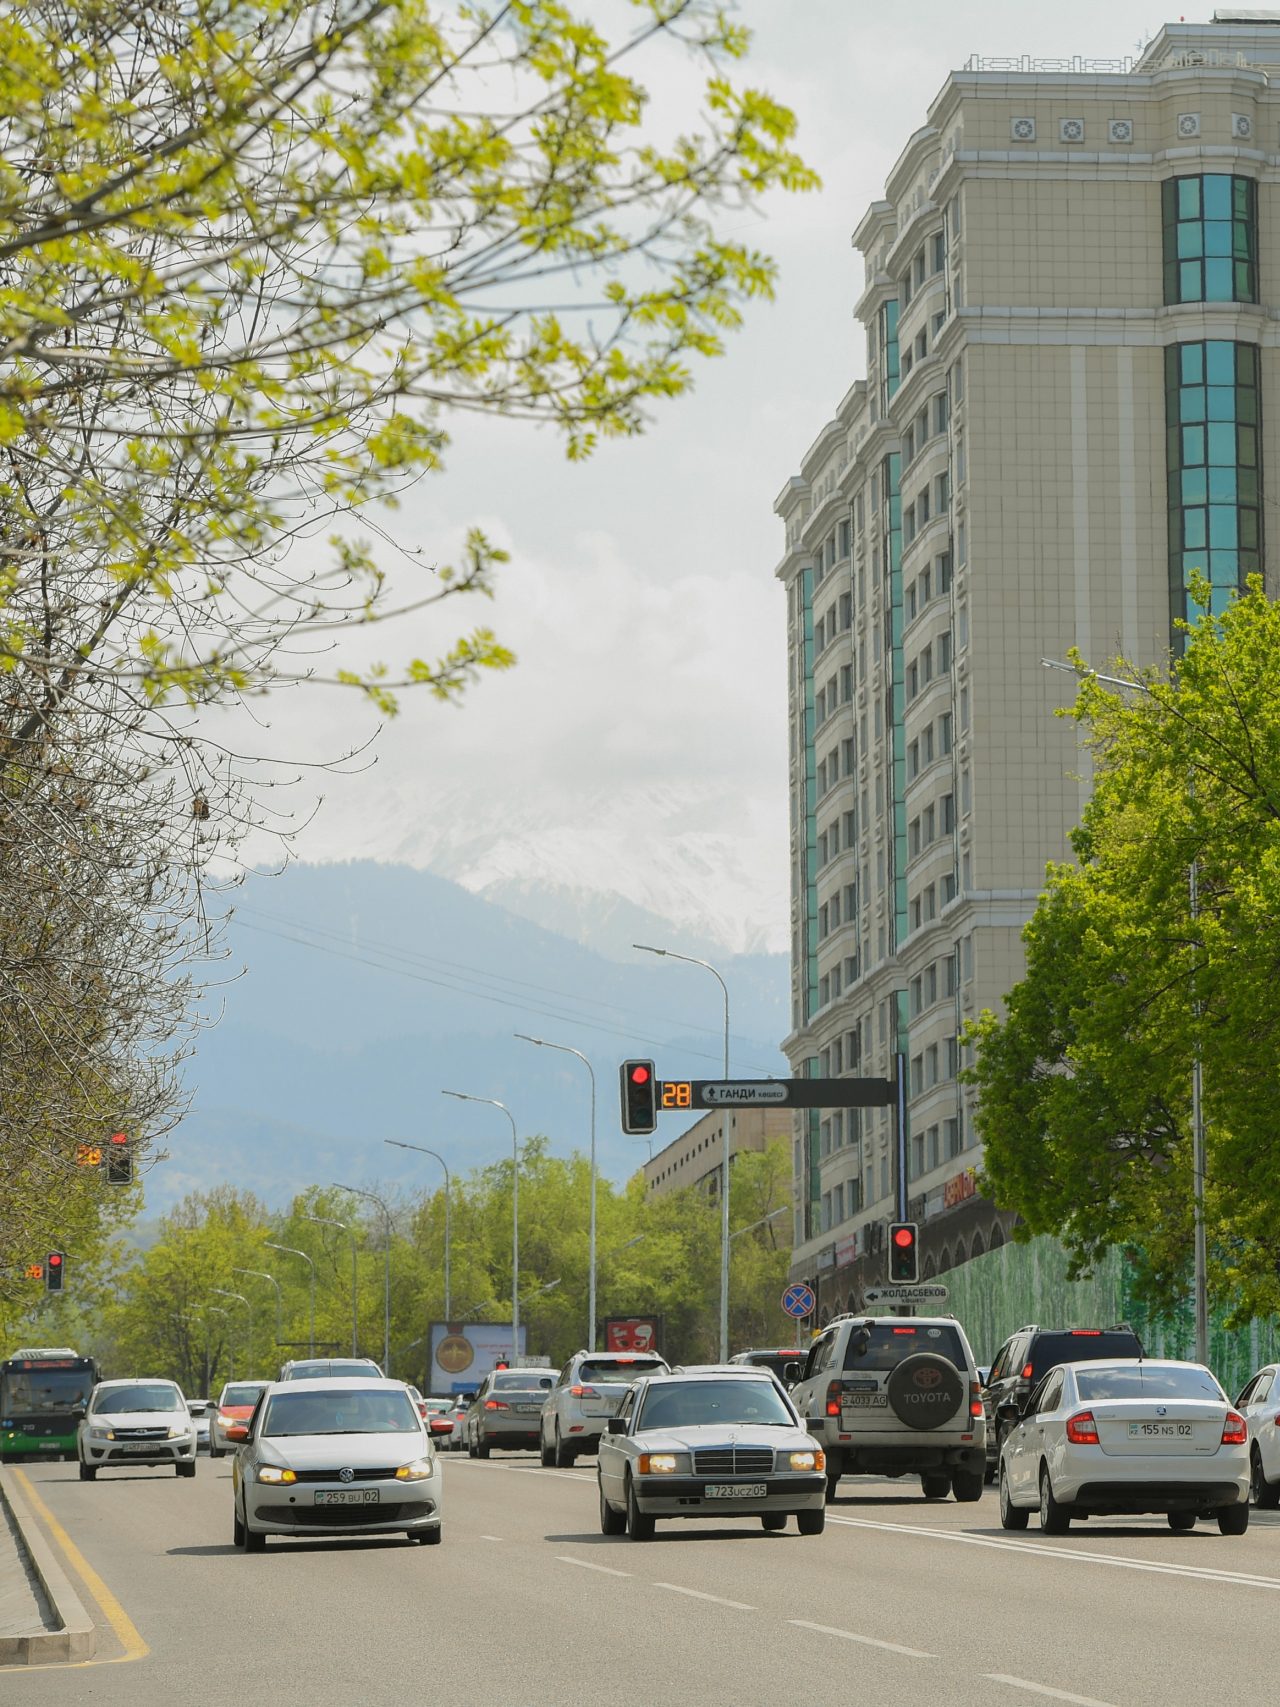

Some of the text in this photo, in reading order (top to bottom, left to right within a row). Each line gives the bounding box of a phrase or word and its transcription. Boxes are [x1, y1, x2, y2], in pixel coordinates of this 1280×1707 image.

[663, 1083, 690, 1106] 28
[720, 1089, 755, 1099] ГАНДИ
[904, 1392, 950, 1403] TOYOTA
[1141, 1424, 1160, 1435] 155
[1162, 1426, 1174, 1435] NS
[1178, 1425, 1191, 1435] 02
[714, 1486, 752, 1497] 723UCZ
[753, 1485, 766, 1495] 05
[326, 1493, 346, 1504] 259
[348, 1494, 361, 1503] BU
[364, 1491, 377, 1502] 02
